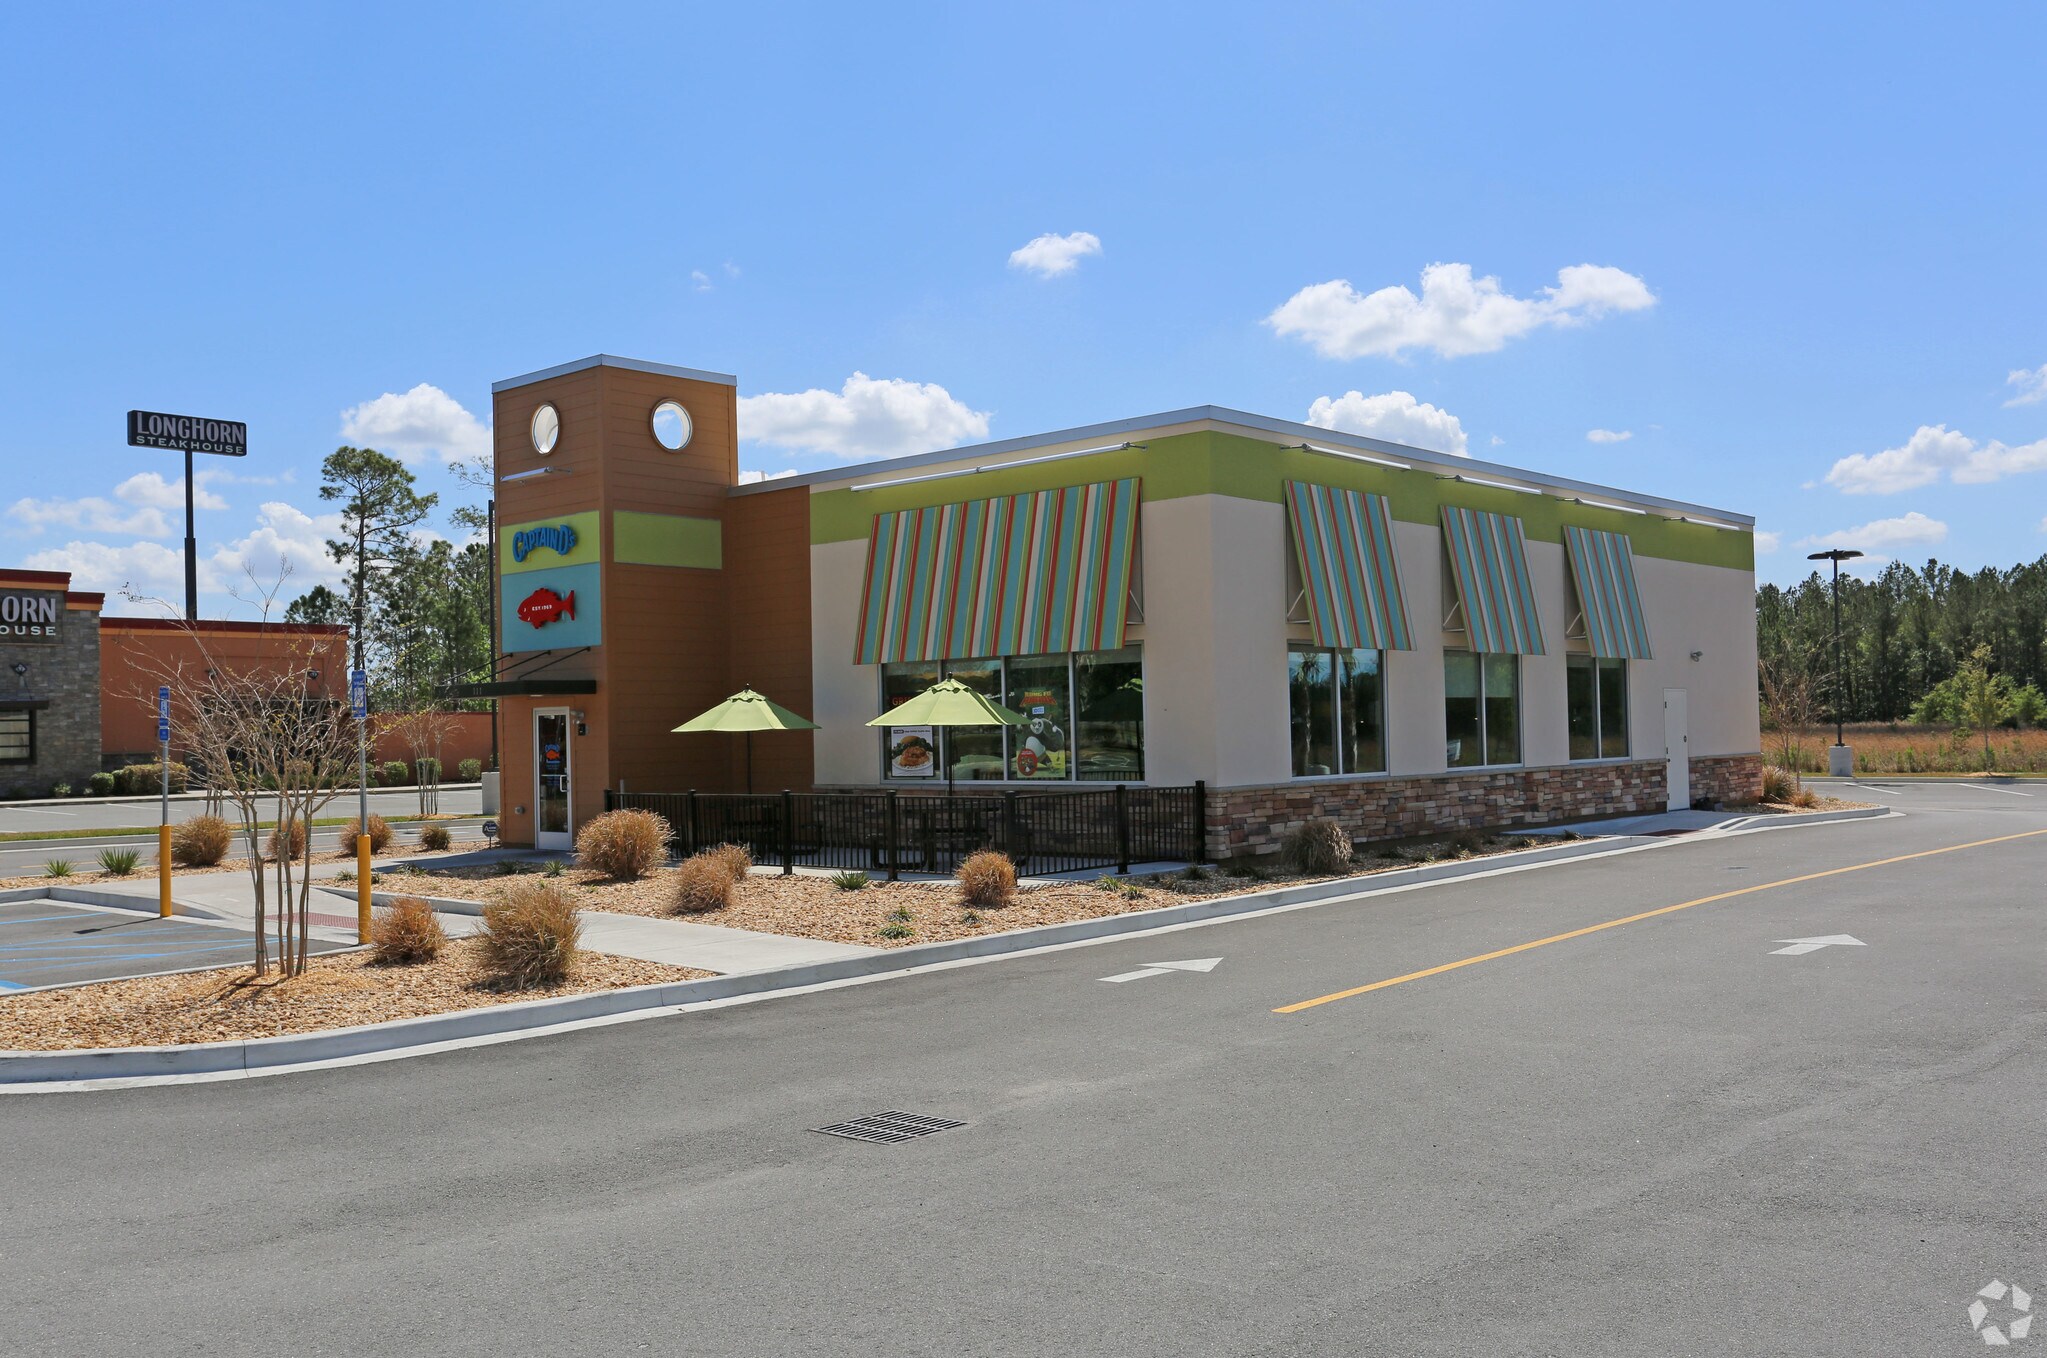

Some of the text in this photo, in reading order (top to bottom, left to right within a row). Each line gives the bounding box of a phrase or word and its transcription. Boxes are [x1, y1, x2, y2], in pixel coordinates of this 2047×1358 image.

[136, 411, 245, 445] LONGHORN
[136, 435, 244, 454] STEAKHOUSE
[512, 527, 560, 563] CAPTAIN
